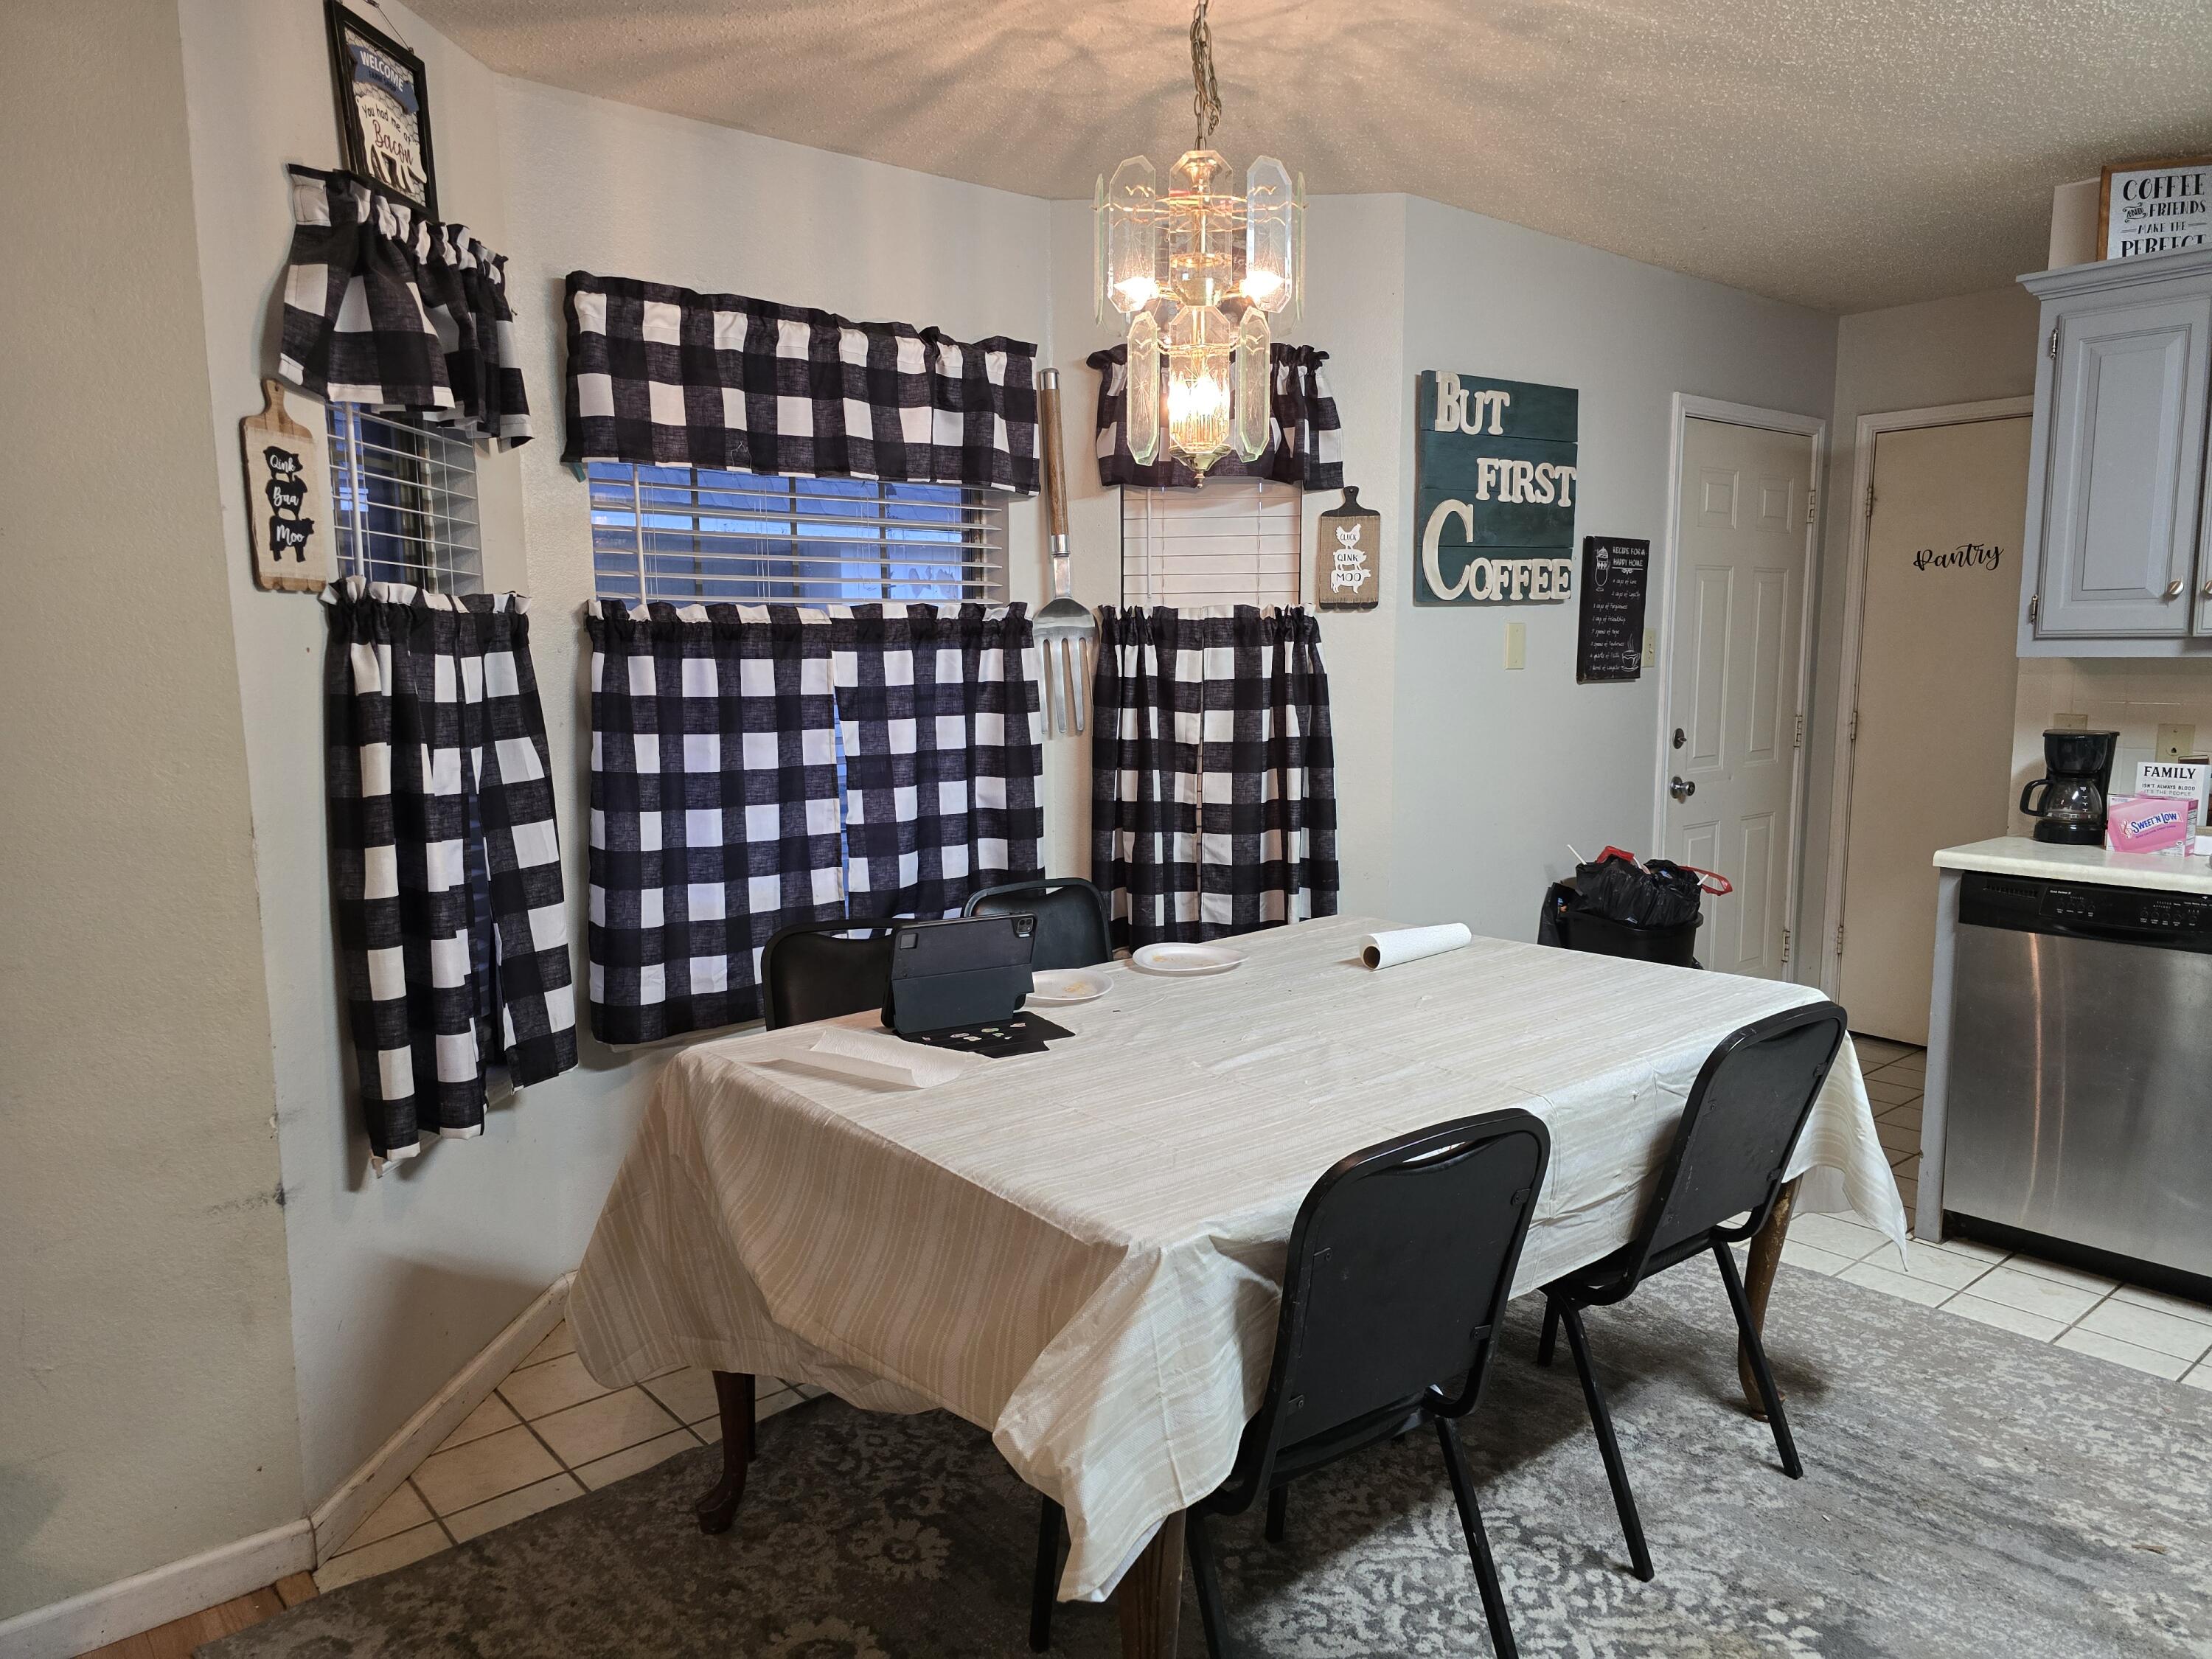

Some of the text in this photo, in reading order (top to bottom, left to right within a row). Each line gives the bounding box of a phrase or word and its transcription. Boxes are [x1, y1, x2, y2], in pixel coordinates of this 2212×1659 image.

[360, 50, 404, 92] WELCOME
[361, 104, 375, 118] You
[376, 103, 389, 122] had
[391, 116, 401, 133] me
[372, 119, 414, 165] Bacon
[2123, 173, 2207, 201] COFFEE
[2126, 200, 2207, 218] AND FRIENDS
[2138, 221, 2186, 234] MAKE THE
[1435, 370, 1510, 435] BUT
[1476, 457, 1576, 507] FIRST
[273, 486, 299, 507] Baa
[276, 524, 305, 546] Moo
[1340, 533, 1357, 541] CLUCK
[1422, 499, 1572, 601] COFFEE
[1913, 543, 2004, 571] Pantry
[1336, 572, 1362, 582] MOO
[2143, 766, 2197, 779] FAMILY
